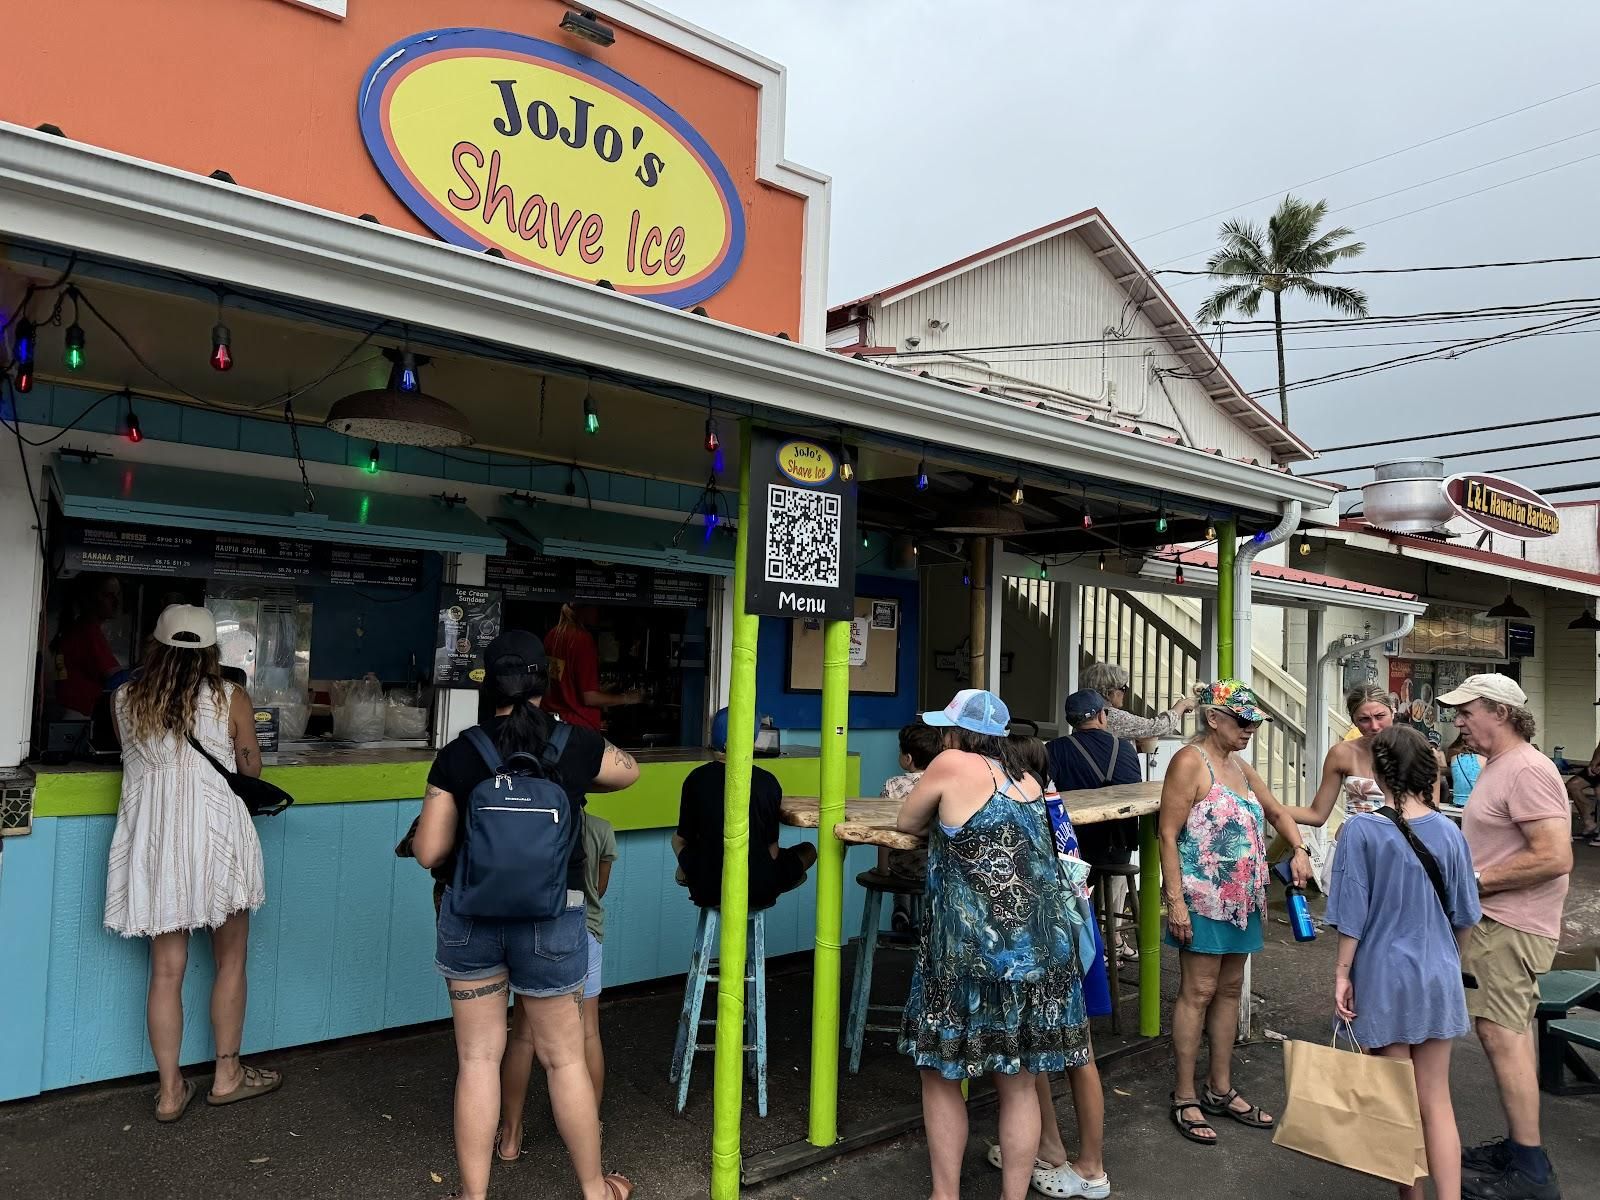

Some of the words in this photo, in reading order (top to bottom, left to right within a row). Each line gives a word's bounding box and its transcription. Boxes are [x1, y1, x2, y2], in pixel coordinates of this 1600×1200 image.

[491, 79, 665, 188] JoJo's
[447, 141, 604, 264] Shave
[626, 209, 686, 276] Ice
[794, 446, 822, 462] JoJo's
[787, 459, 814, 479] Shave
[815, 464, 827, 479] Ice
[1490, 491, 1526, 523] Hawaiian
[1527, 504, 1560, 533] Barbecue
[82, 552, 112, 561] BANANA
[115, 554, 134, 562] SPLIT
[456, 588, 467, 596] Ice
[468, 590, 489, 598] Cream
[778, 591, 826, 613] Menu
